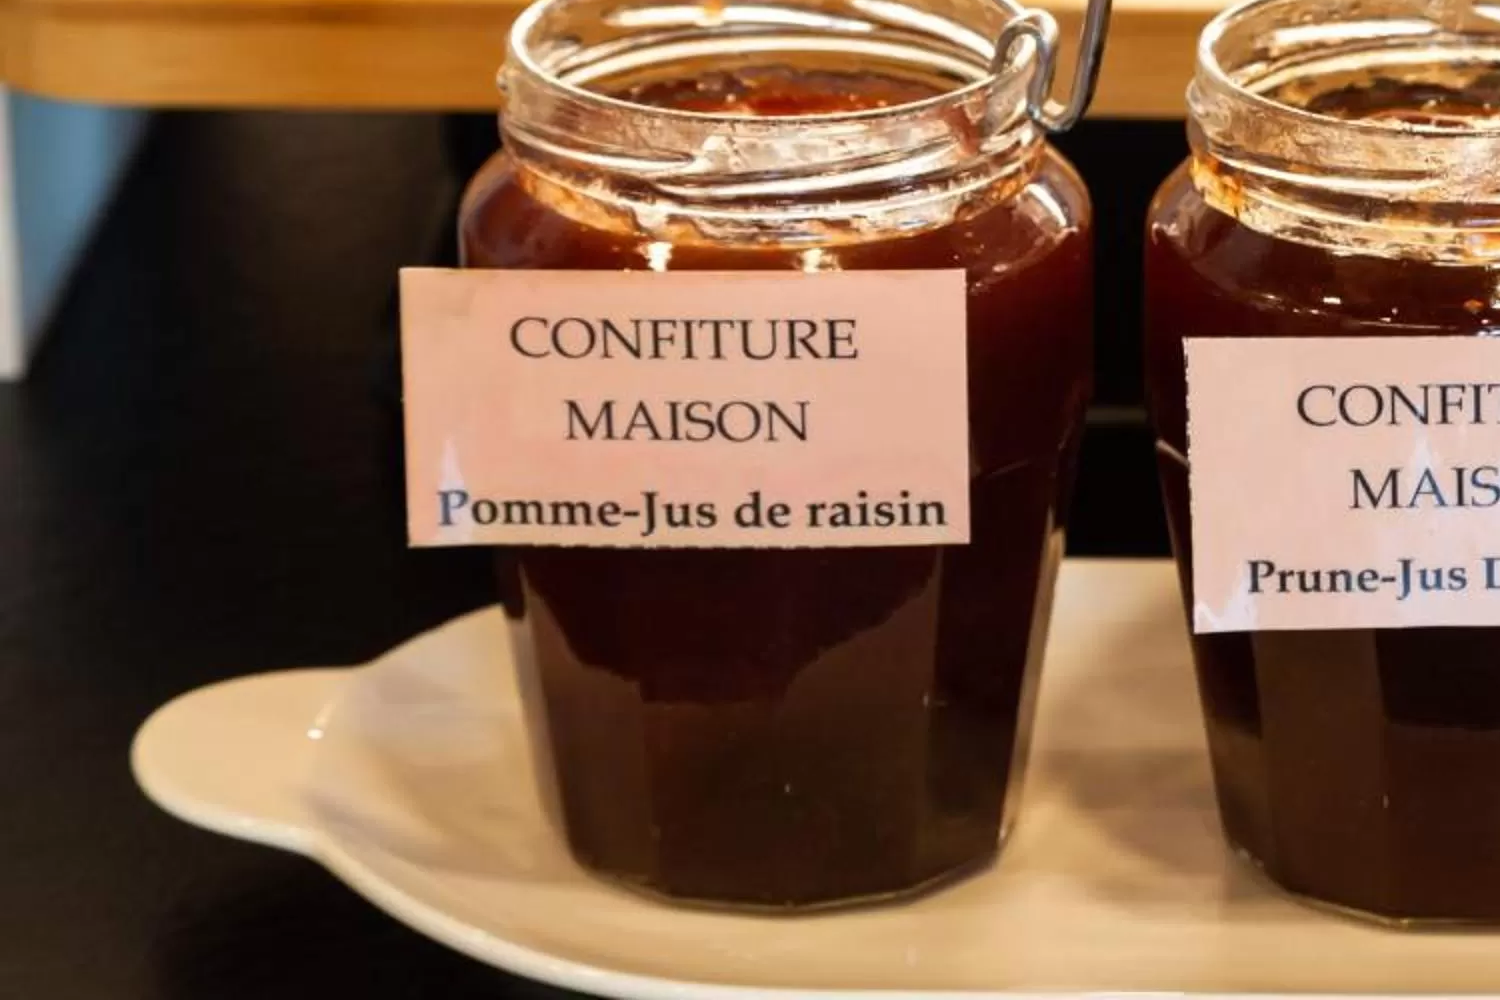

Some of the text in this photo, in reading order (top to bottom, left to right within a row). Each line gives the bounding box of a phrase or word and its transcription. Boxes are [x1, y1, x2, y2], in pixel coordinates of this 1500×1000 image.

[509, 316, 859, 361] CONFITURE
[564, 399, 811, 443] MAISON
[437, 489, 949, 536] Pomme-Jus de raisin
[1248, 557, 1468, 601] Prune-Jus
